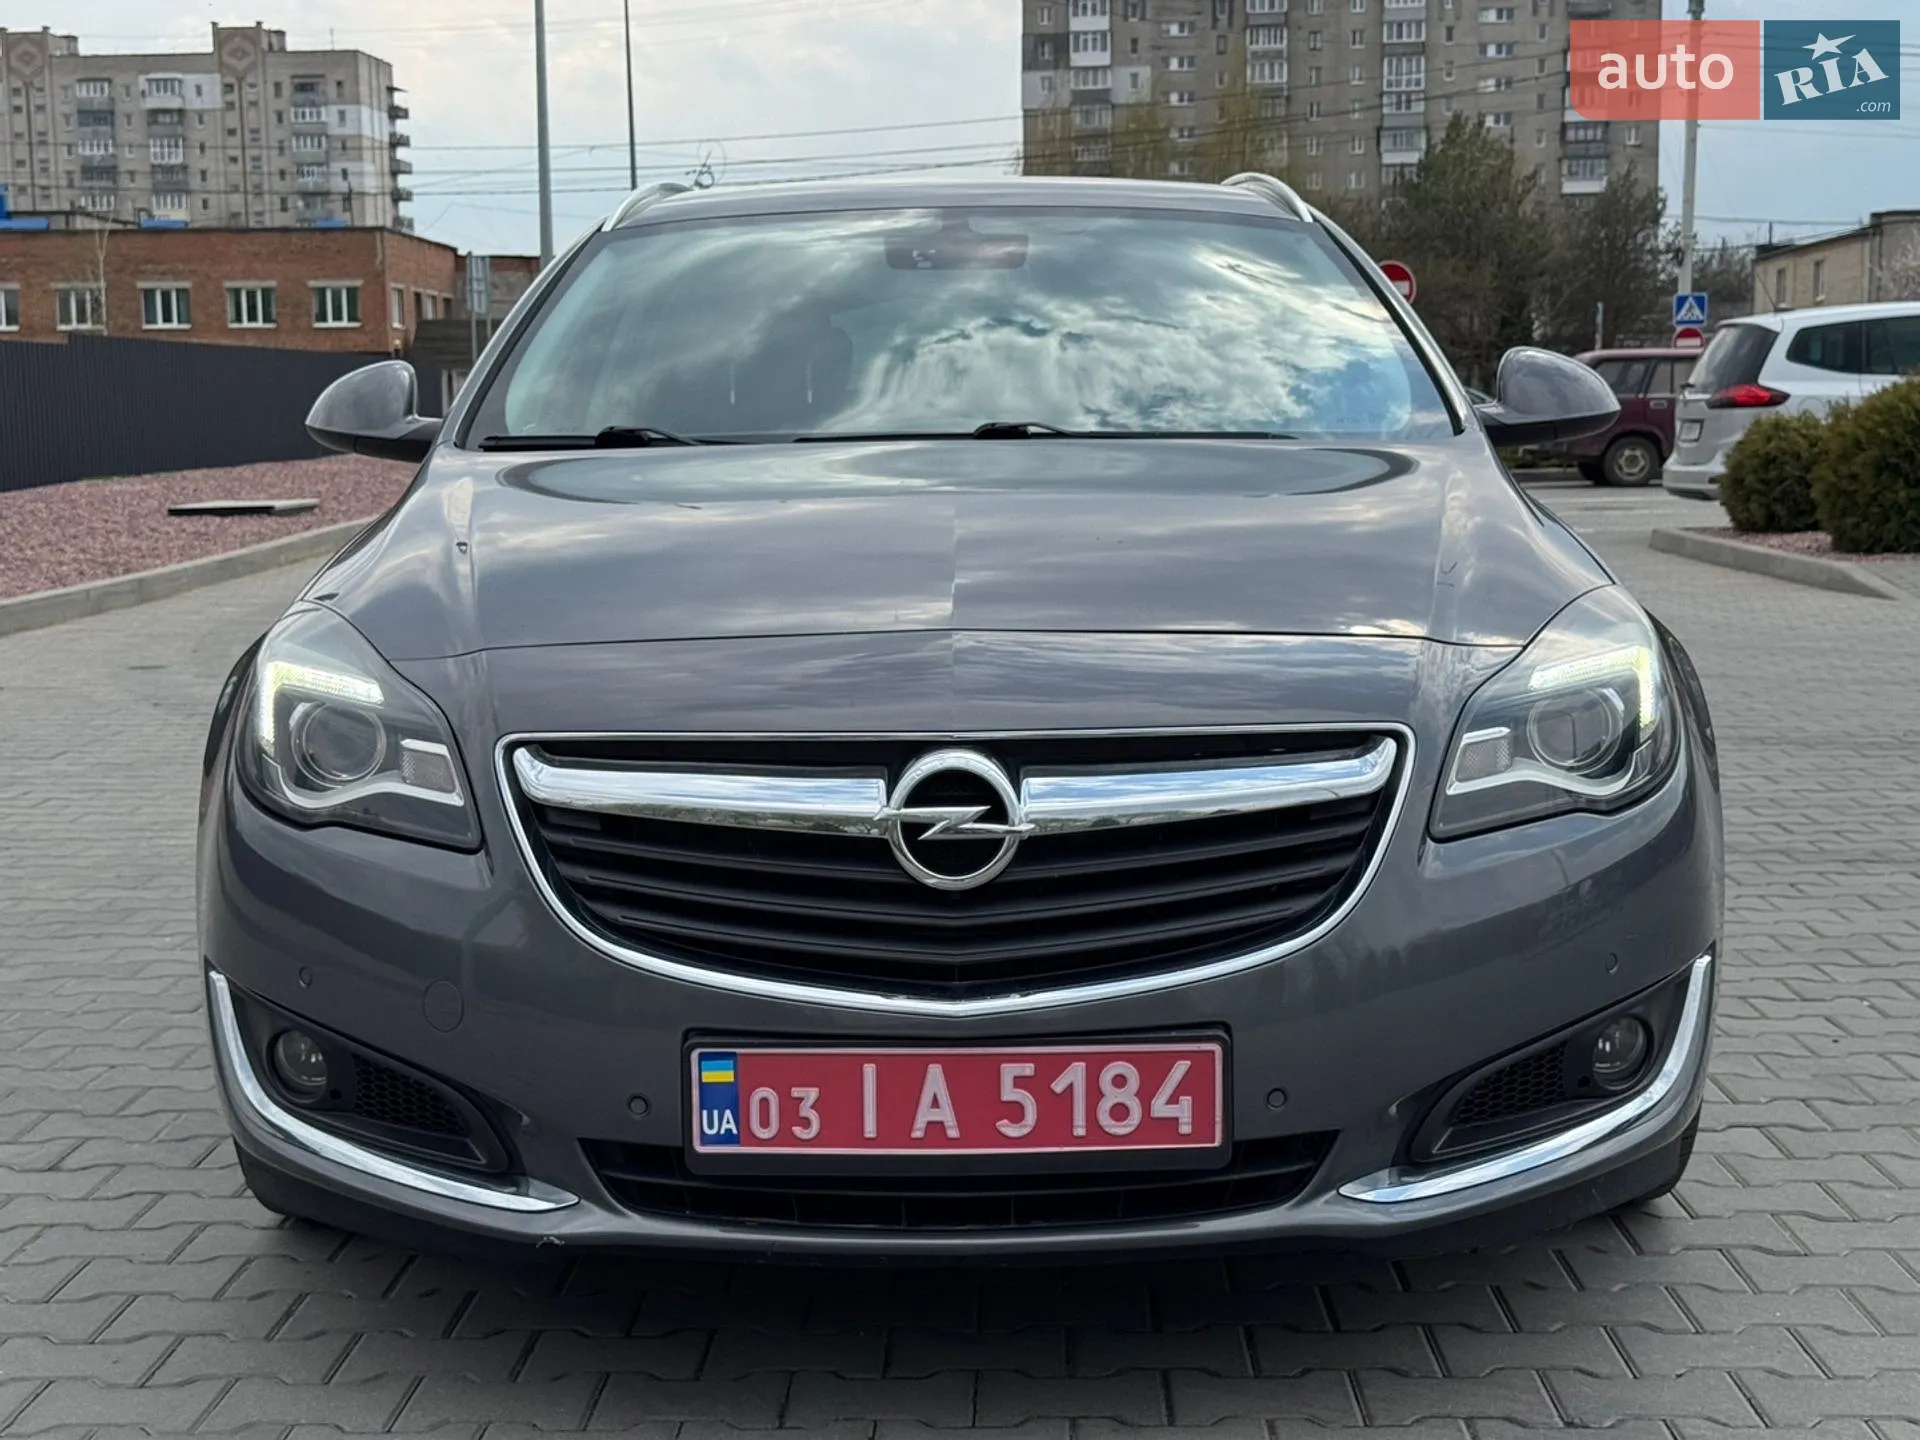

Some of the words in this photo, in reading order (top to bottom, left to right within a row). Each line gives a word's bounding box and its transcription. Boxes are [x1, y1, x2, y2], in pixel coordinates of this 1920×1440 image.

[701, 1109, 738, 1135] UA
[749, 1086, 821, 1140] 03
[996, 1060, 1193, 1137] 5184
